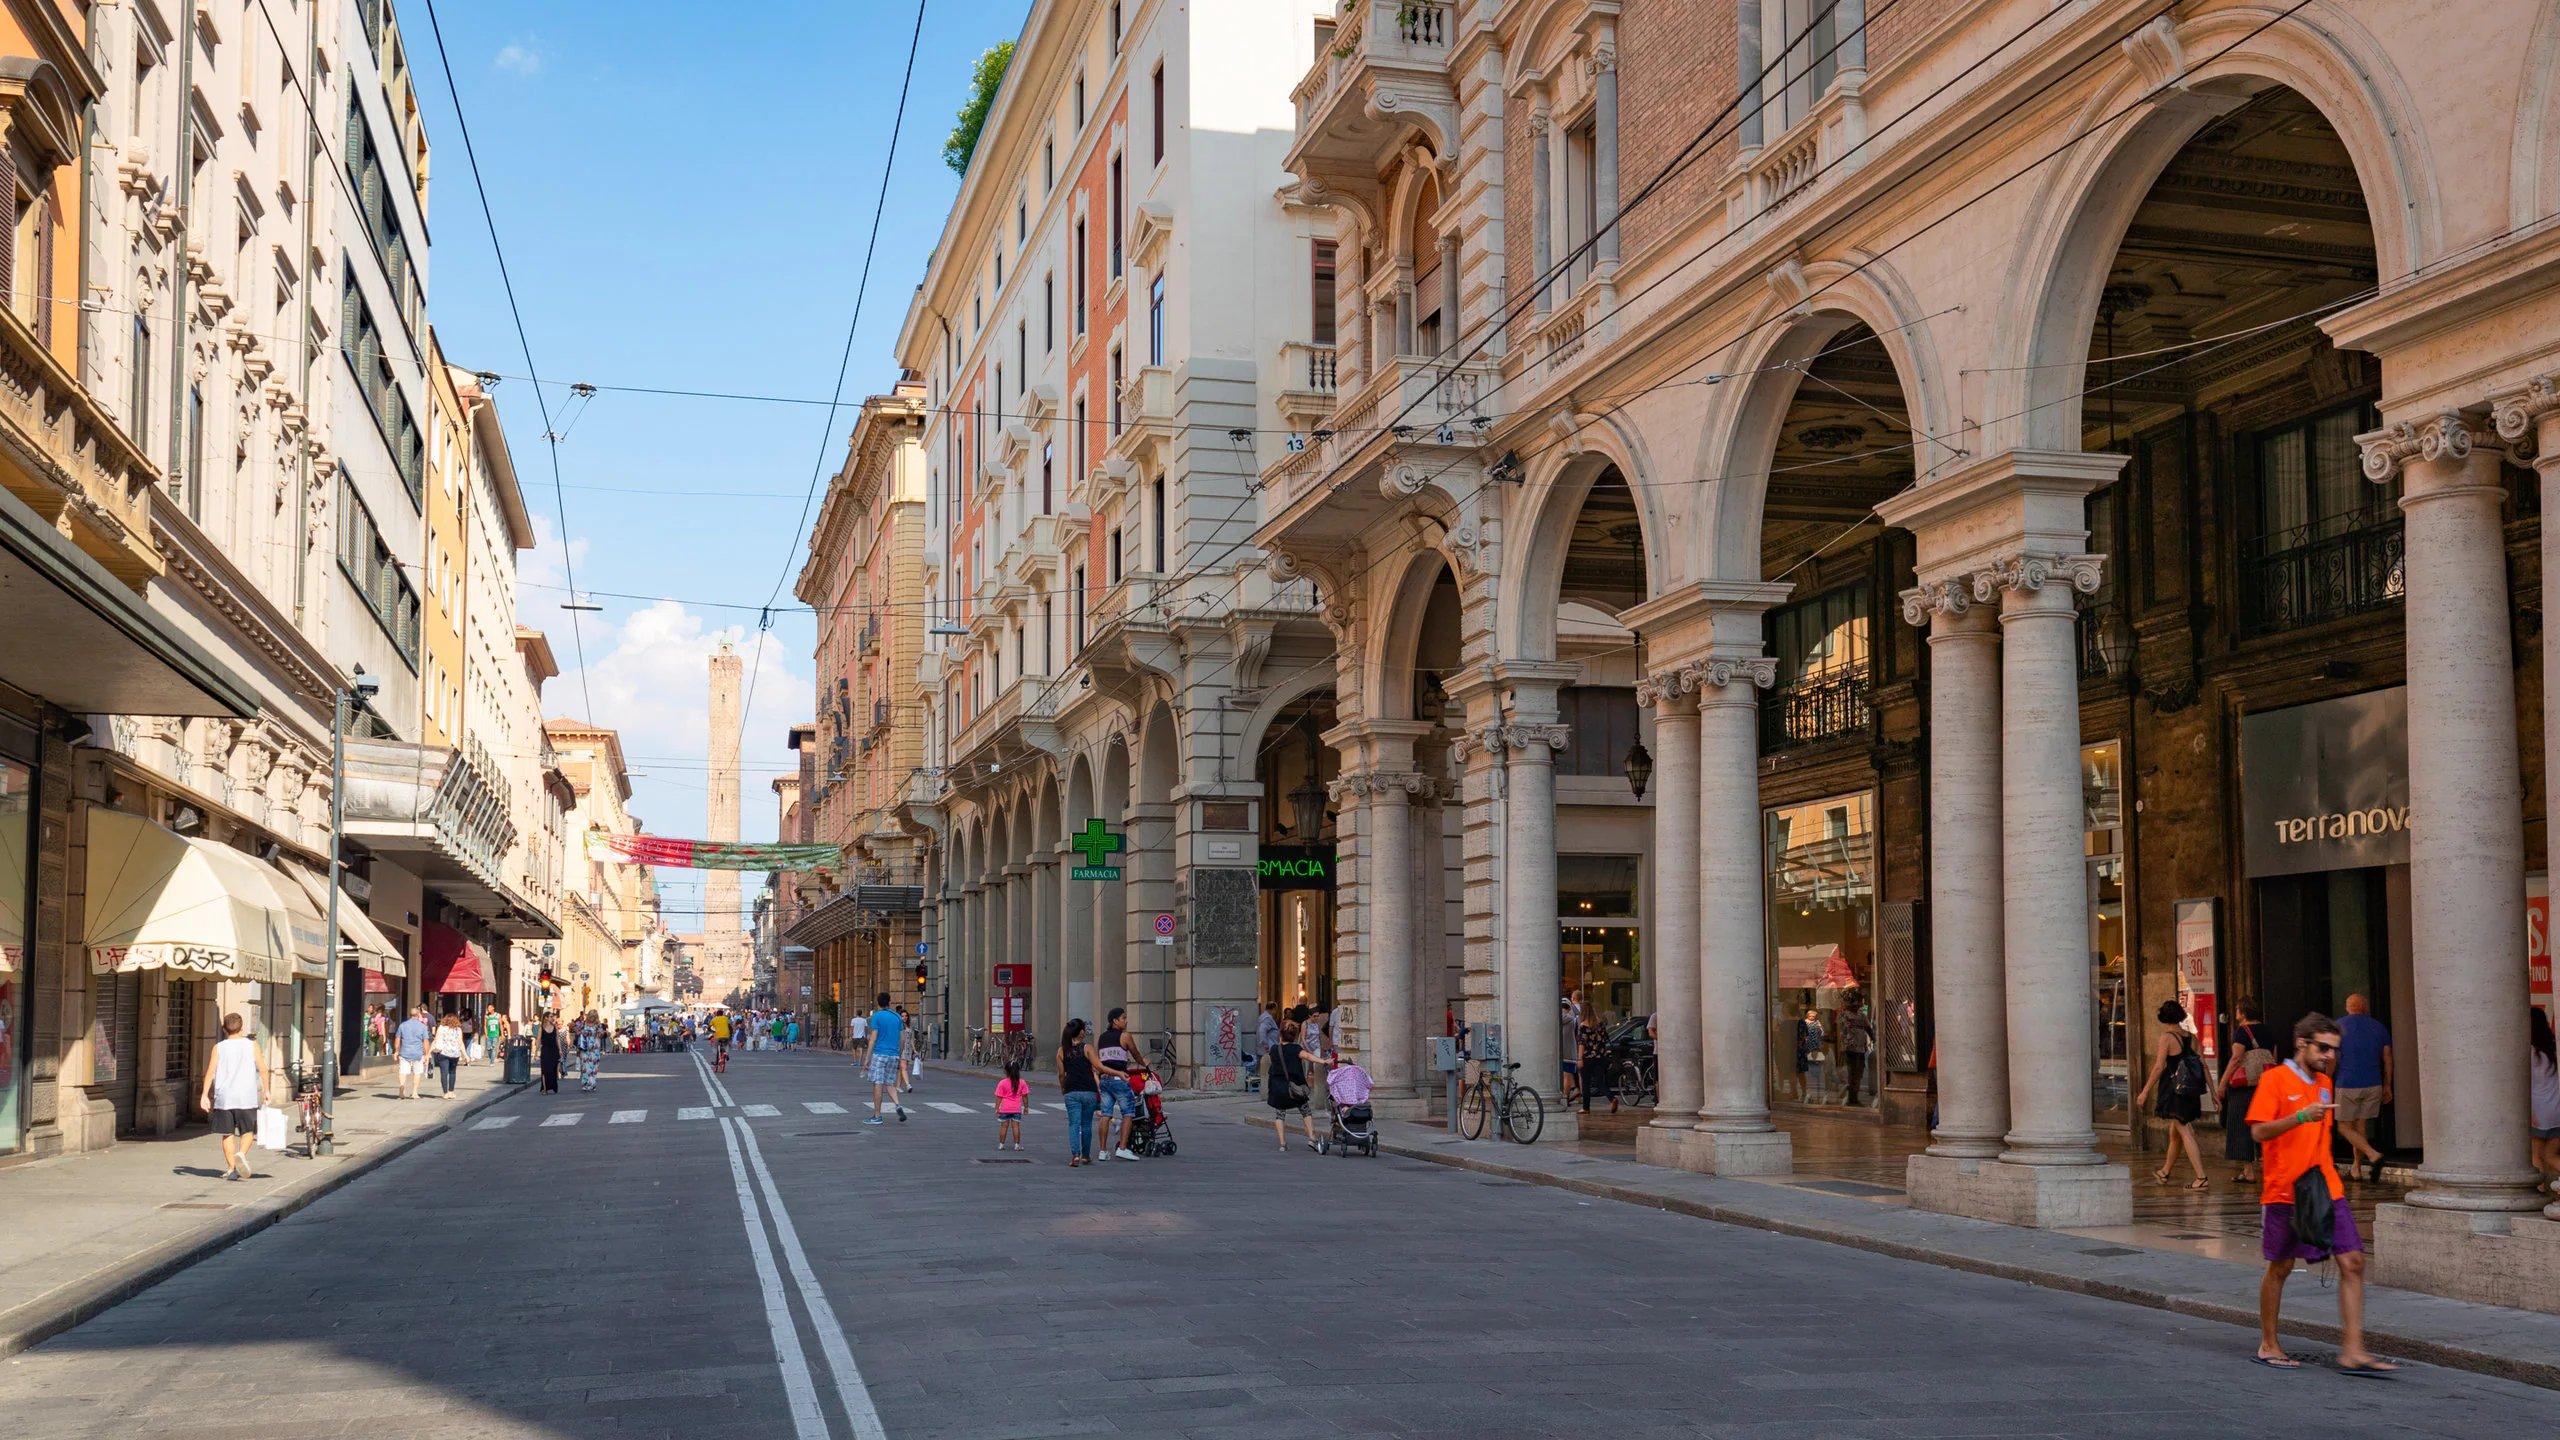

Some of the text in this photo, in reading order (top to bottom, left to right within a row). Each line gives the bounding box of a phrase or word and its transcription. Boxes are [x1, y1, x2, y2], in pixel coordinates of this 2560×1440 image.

[1437, 431, 1454, 443] 14
[1287, 440, 1304, 451] 13
[1073, 869, 1119, 879] FARMACIA
